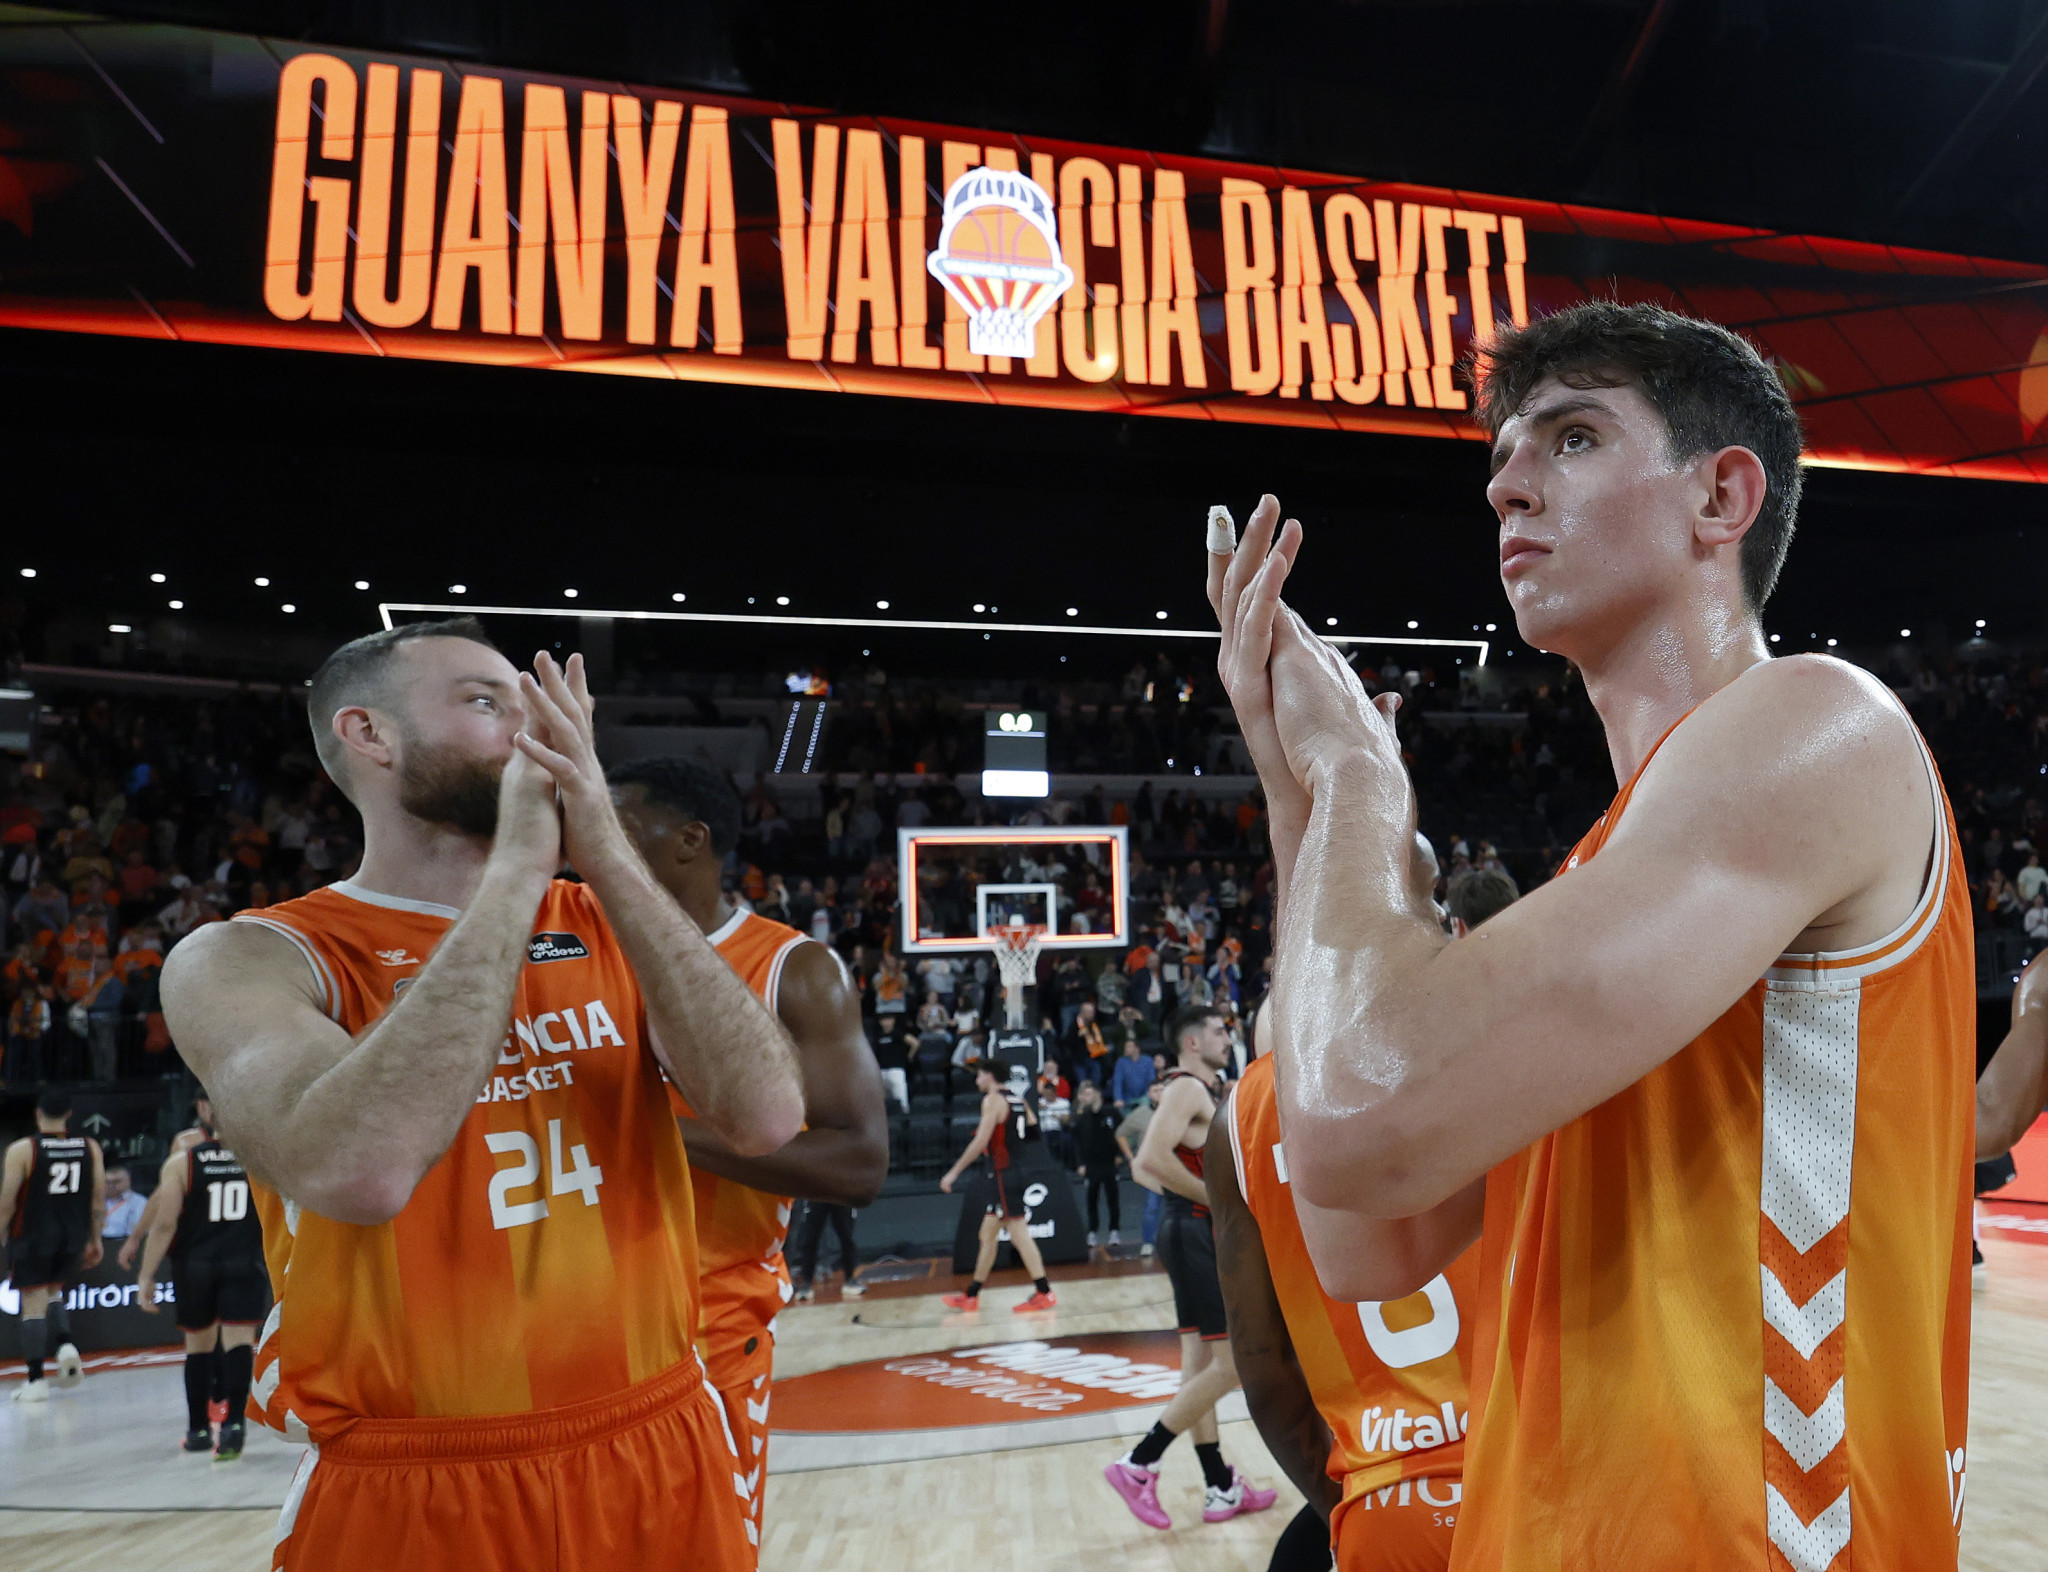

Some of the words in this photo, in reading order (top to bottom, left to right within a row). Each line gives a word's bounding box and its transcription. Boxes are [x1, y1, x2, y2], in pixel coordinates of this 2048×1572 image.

[264, 53, 742, 355] GUANYA
[1221, 177, 1527, 409] BASKET!
[533, 947, 585, 959] endesa
[498, 1000, 626, 1065] ENCIA
[48, 1161, 81, 1194] 21
[484, 1119, 603, 1230] 24
[207, 1180, 248, 1222] 10
[1361, 1401, 1468, 1452] Vital
